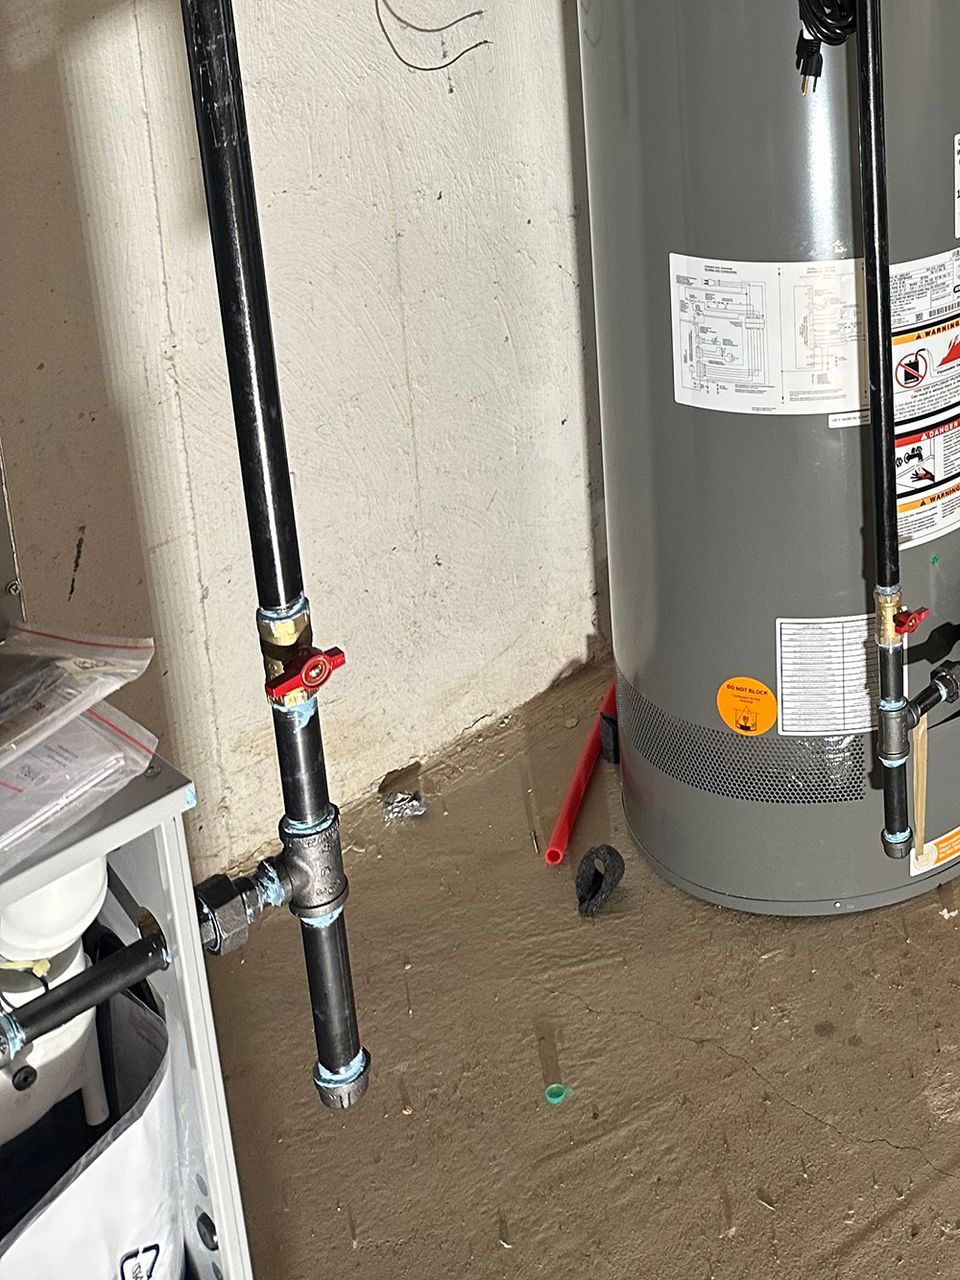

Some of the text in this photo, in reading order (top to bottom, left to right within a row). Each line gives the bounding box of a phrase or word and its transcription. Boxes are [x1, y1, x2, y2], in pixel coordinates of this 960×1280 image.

[925, 320, 960, 337] WARNING
[929, 421, 958, 438] DANGER
[930, 483, 960, 502] WARNING
[749, 688, 768, 696] BLOCK
